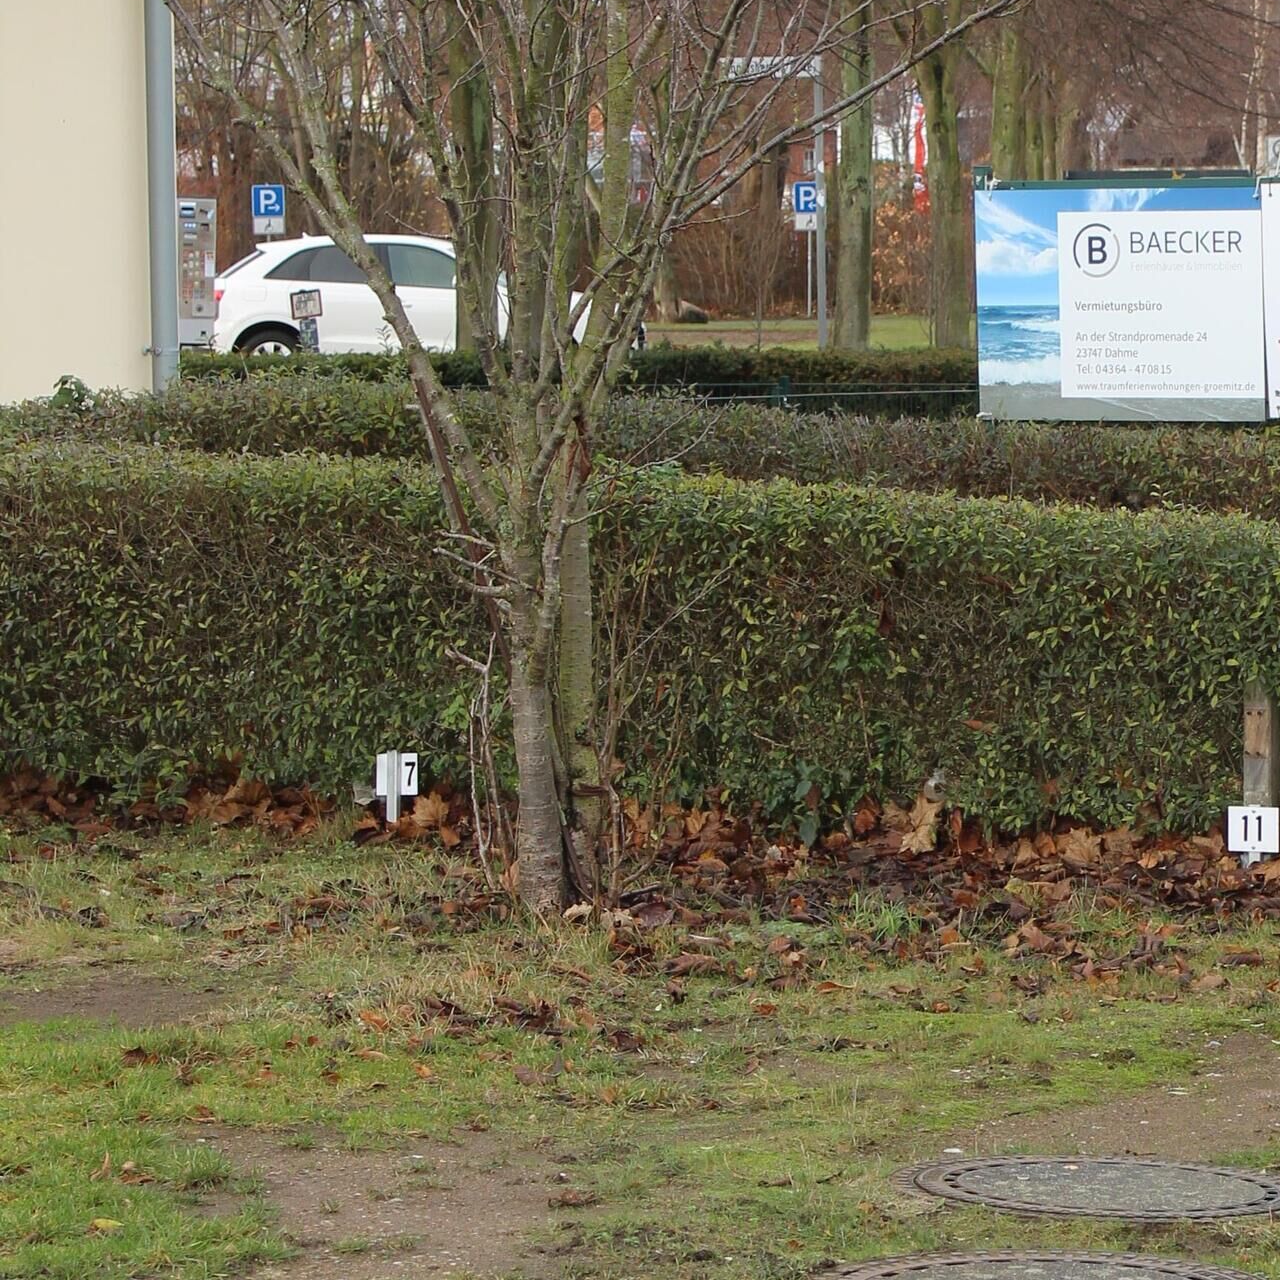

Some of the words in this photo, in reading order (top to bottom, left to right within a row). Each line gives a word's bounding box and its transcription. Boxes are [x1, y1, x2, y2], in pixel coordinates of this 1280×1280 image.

[260, 190, 276, 213] P
[800, 186, 816, 210] P
[1088, 236, 1107, 264] B
[1129, 231, 1242, 254] BAECKER
[1074, 299, 1163, 314] Vermietungsbüro
[1075, 331, 1088, 342] An
[1090, 331, 1107, 342] der
[1108, 331, 1194, 344] Strandpromenade
[1196, 331, 1208, 342] 24
[1076, 347, 1102, 358] 23747
[1104, 346, 1139, 359] Dahme
[1076, 381, 1257, 393] www.traumferienwohnungen-groemitz.de
[405, 762, 416, 786] 7
[1242, 815, 1262, 841] 11
